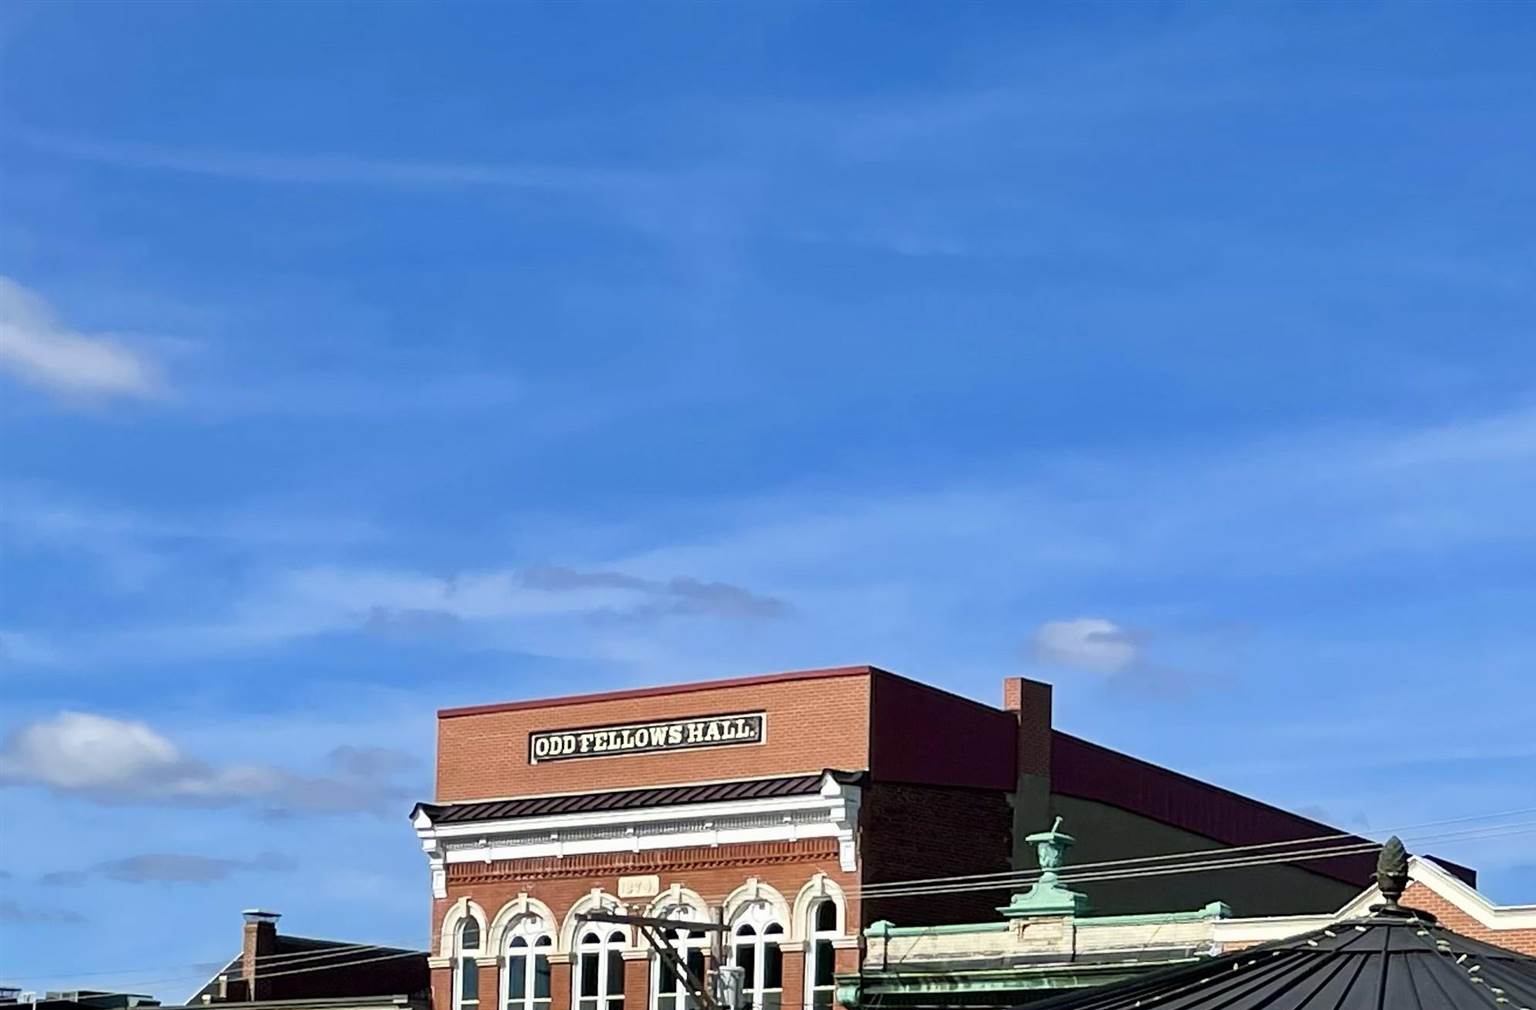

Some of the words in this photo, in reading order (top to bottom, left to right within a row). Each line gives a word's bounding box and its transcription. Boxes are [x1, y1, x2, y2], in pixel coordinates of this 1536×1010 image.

[535, 734, 576, 756] ODD
[580, 724, 683, 753] FELLOWS
[687, 718, 757, 743] HALL.
